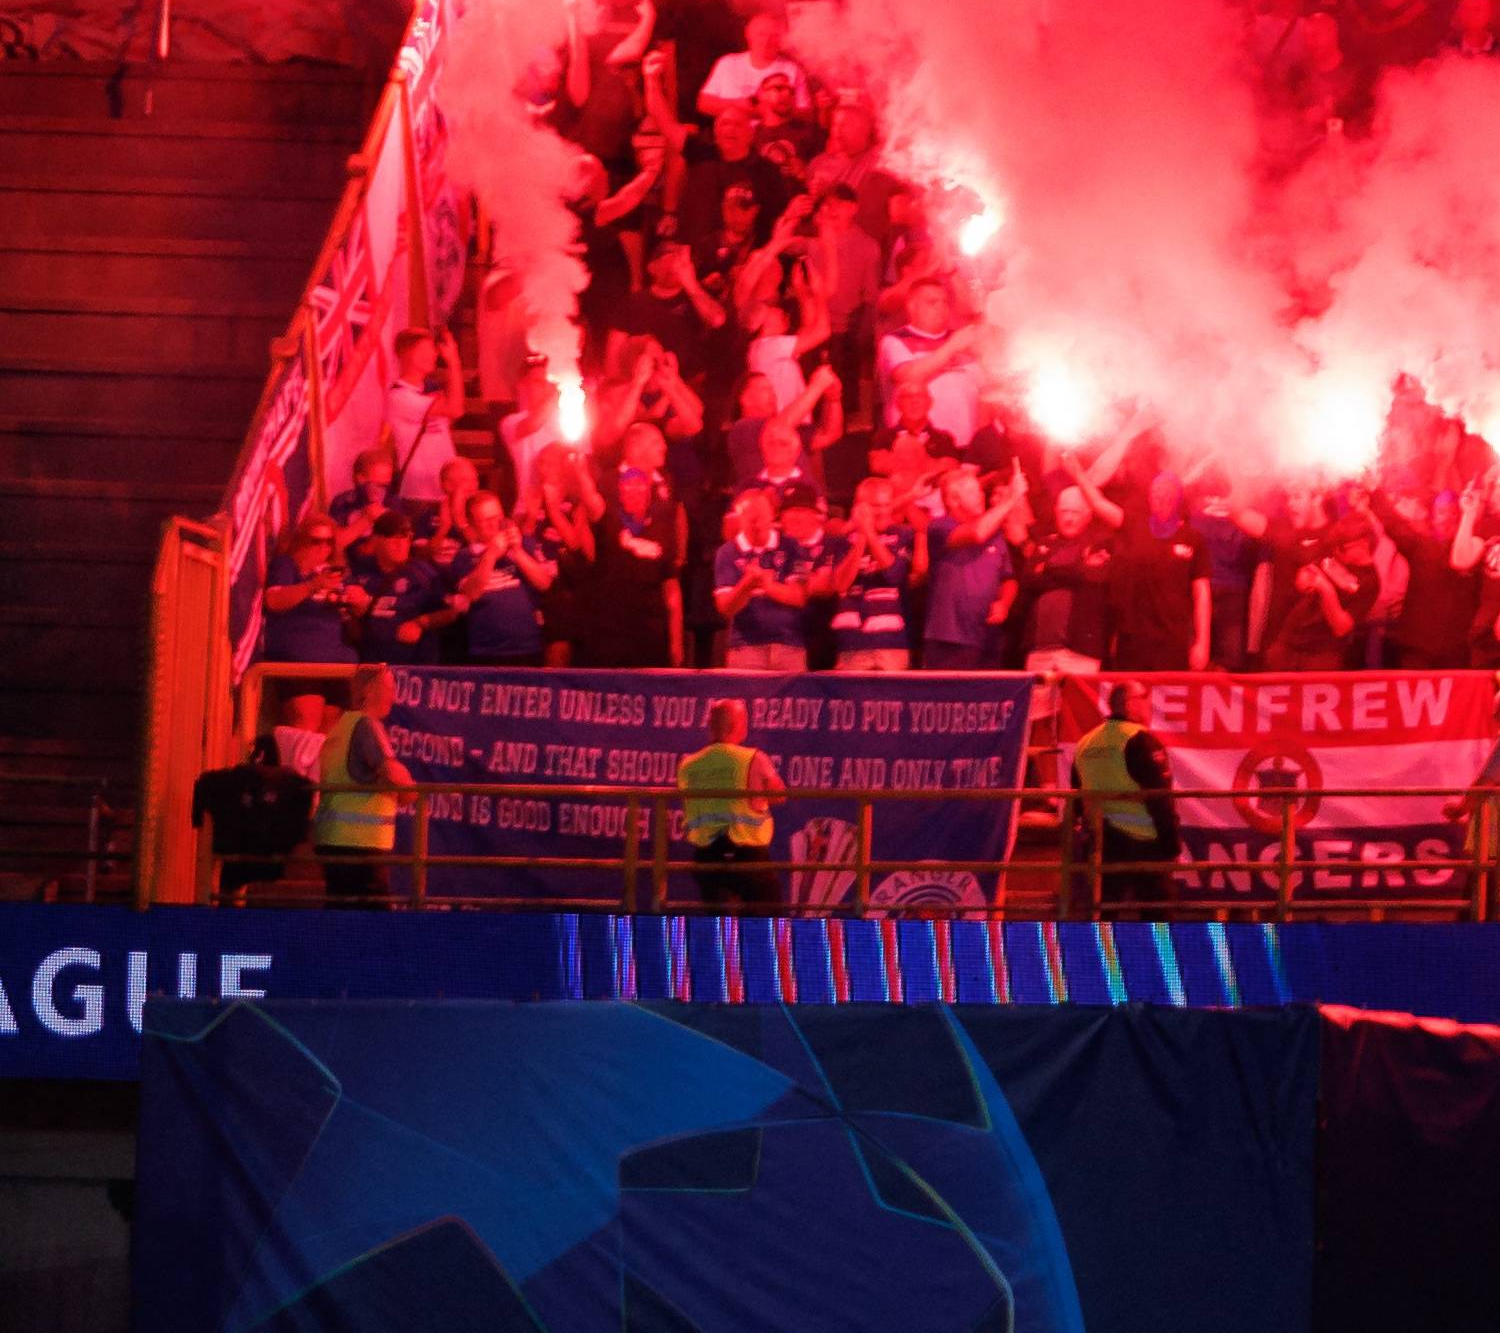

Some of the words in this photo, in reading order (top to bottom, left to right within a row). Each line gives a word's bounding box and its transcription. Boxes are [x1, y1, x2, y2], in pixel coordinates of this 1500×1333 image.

[396, 672, 423, 706] DO
[429, 678, 475, 714] NOT
[480, 683, 552, 719] ENTER
[559, 689, 646, 726] UNLESS
[652, 694, 698, 729] YOU
[752, 697, 824, 730] READY
[828, 699, 856, 731] TO
[861, 700, 902, 733] PUT
[909, 699, 1015, 734] YOURSELF
[1102, 677, 1454, 735] ENFREW
[389, 725, 465, 767] SECOND
[487, 741, 538, 774] AND
[543, 743, 602, 779] THAT
[606, 748, 680, 783] SHOUL
[787, 755, 835, 788] ONE
[840, 757, 887, 789] AND
[891, 758, 947, 791] ONLY
[952, 755, 1003, 789] TIME
[469, 794, 492, 826] IS
[497, 799, 551, 831] GOOD
[1170, 839, 1456, 894] ANGERS
